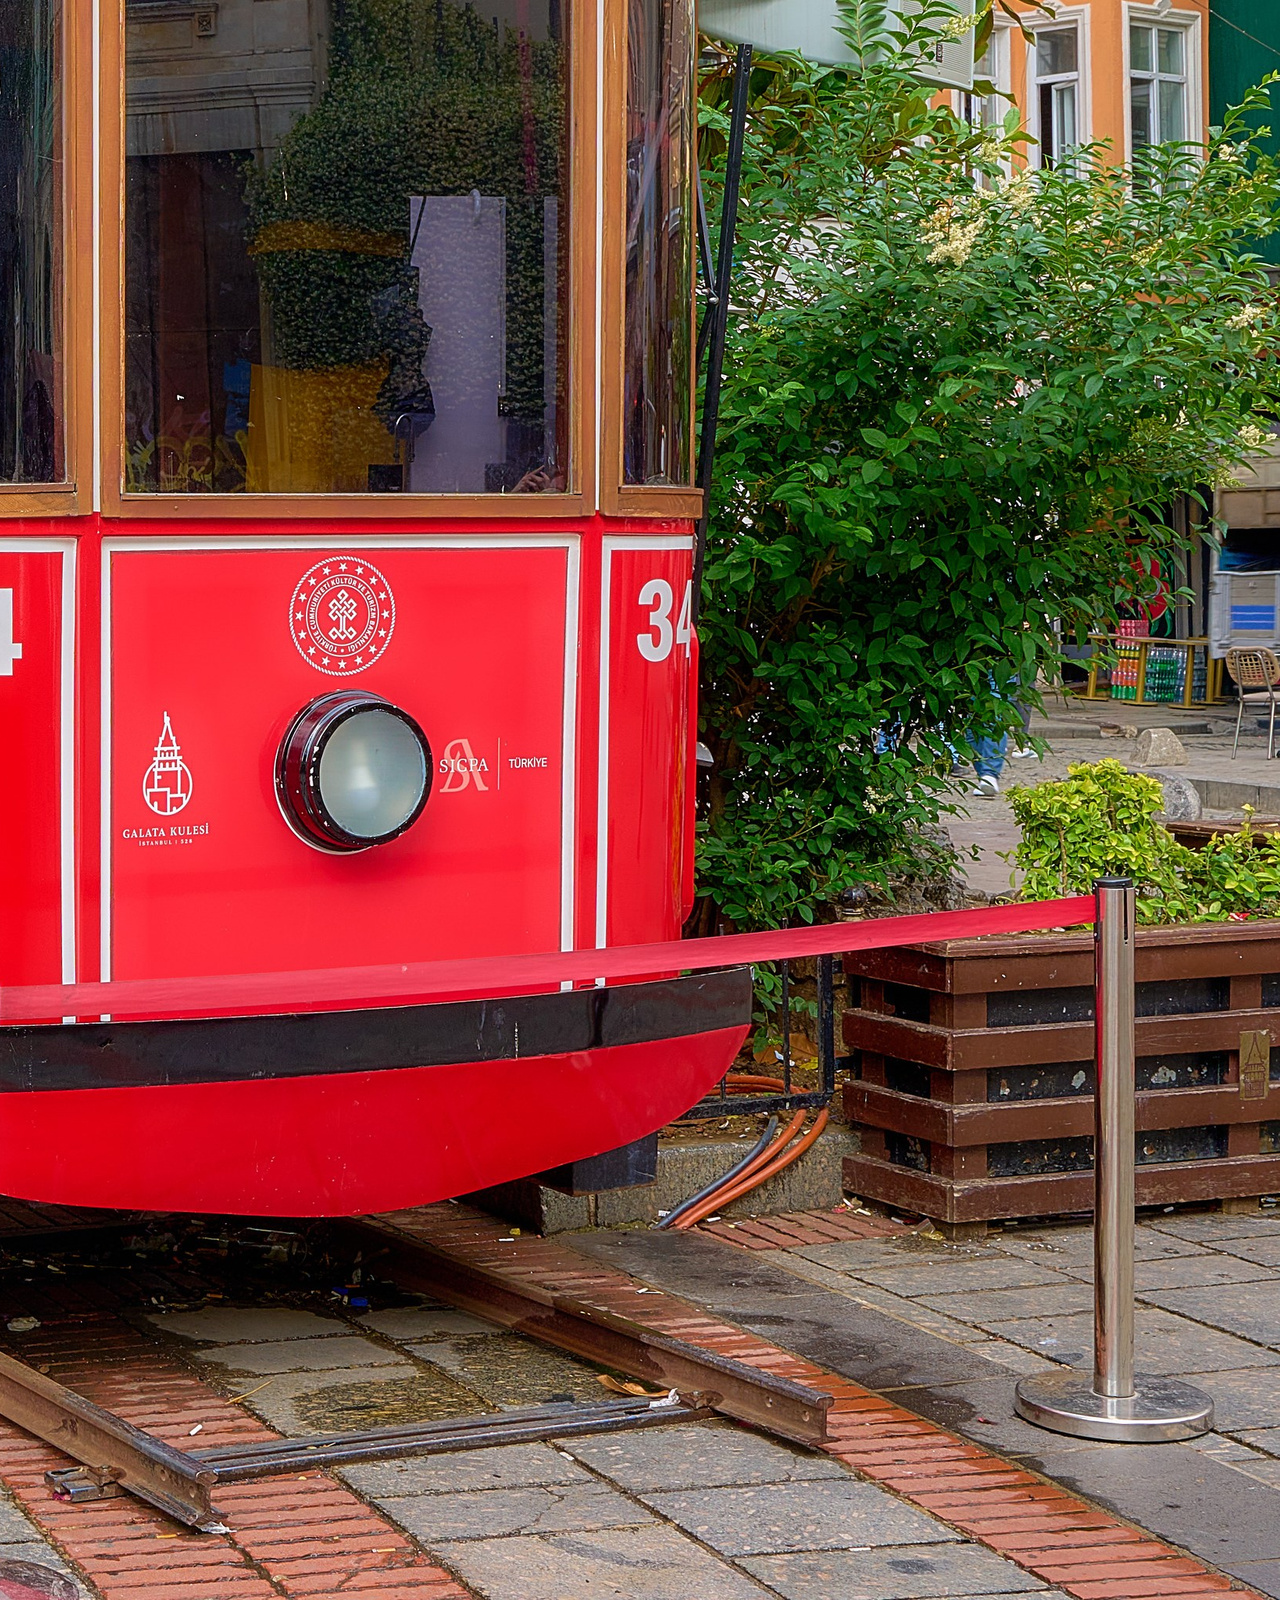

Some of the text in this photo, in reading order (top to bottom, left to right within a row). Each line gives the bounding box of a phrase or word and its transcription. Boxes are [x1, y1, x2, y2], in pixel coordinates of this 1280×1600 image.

[331, 577, 357, 586] KÜLTÜR
[358, 582, 366, 592] VE
[440, 757, 548, 773] SICPA TÜRKİYE
[122, 822, 209, 838] GALATA KULESİ
